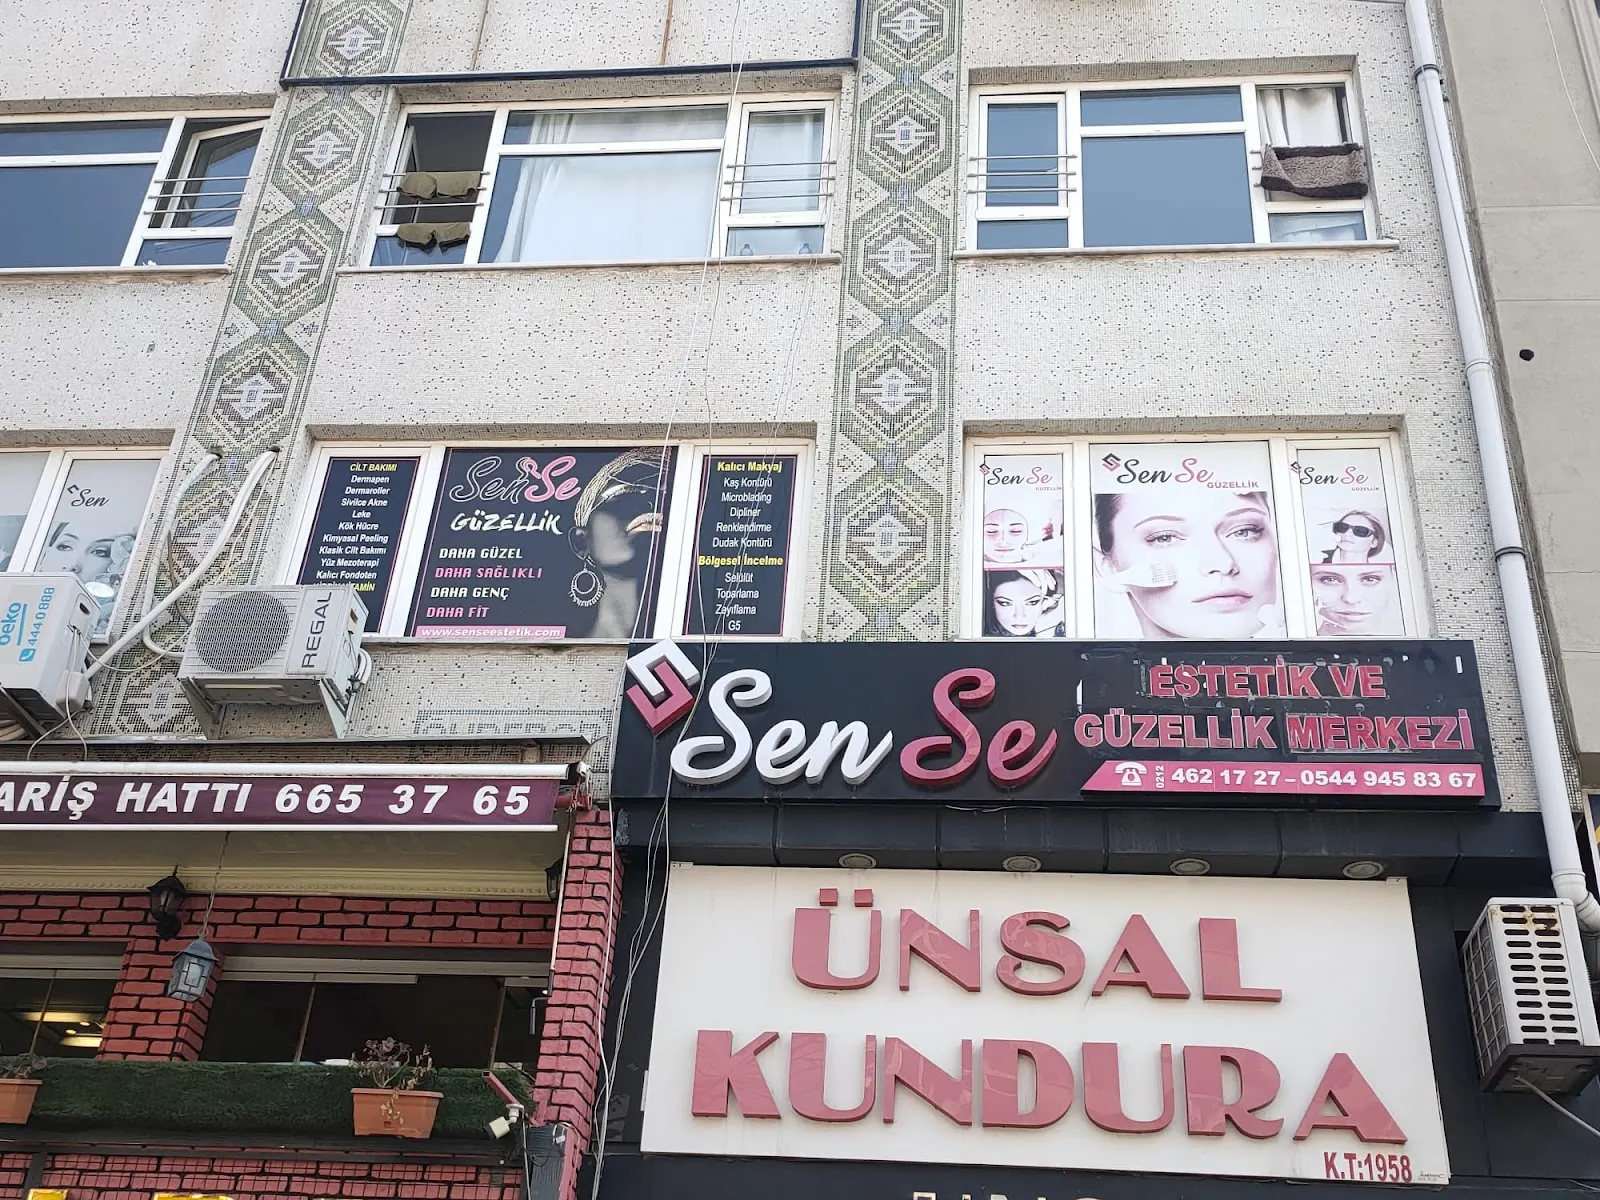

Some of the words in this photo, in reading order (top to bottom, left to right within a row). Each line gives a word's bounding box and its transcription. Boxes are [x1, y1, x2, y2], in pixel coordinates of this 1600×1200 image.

[350, 463, 369, 472] CİLT
[368, 463, 398, 472] BAKIMI
[747, 461, 782, 473] Makyaj
[1116, 458, 1172, 484] Sen
[1174, 457, 1214, 484] Se
[351, 475, 390, 485] Dermapen
[988, 467, 1025, 486] Sen
[1026, 466, 1053, 485] Se
[1300, 466, 1339, 485] Sen
[1340, 466, 1369, 485] Se
[723, 477, 740, 489] Kaş
[1207, 481, 1259, 489] GÜZELLİK
[71, 488, 109, 507] Sen
[341, 498, 367, 507] Sivilce
[367, 498, 388, 507] Akne
[721, 492, 772, 504] Microblading
[352, 510, 371, 518] Leke
[730, 507, 761, 519] Dipliner
[338, 522, 354, 530] Kök
[355, 522, 379, 531] Hücre
[450, 509, 563, 535] GÜZELLİK
[716, 522, 772, 532] Renklendirme
[322, 534, 359, 544] Kimyasal
[359, 534, 389, 544] Peeling
[712, 537, 739, 547] Dudak
[319, 546, 343, 554] Klasik
[344, 546, 359, 554] Cilt
[439, 548, 476, 559] DAHA
[480, 546, 523, 559] GÜZEL
[320, 558, 335, 567] Yüz
[336, 558, 380, 568] Mezoterapi
[698, 556, 741, 568] Bölgesel
[743, 553, 784, 565] İncelme
[434, 567, 472, 578] DAHA
[476, 565, 543, 578] SAĞLIKLI
[430, 587, 468, 598] DAHA
[472, 587, 510, 599] GENÇ
[716, 588, 759, 599] Toparlama
[426, 607, 464, 618] DAHA
[468, 606, 490, 618] FİT
[301, 591, 333, 668] REGAL
[728, 620, 741, 631] G5
[421, 627, 561, 638] www.senseestetik.com
[1148, 655, 1318, 698] ESTETİK
[1326, 665, 1387, 698] VE
[670, 668, 893, 786] Sen
[900, 667, 1058, 787] Se
[1073, 708, 1277, 749] GÜZELLİK
[1286, 708, 1475, 751] MERKEZİ
[1155, 765, 1164, 789] 0212
[1171, 768, 1213, 784] 462
[1220, 769, 1246, 785] 17
[1253, 770, 1281, 786] 27
[1300, 770, 1357, 786] 0544
[1363, 771, 1406, 787] 945
[1413, 772, 1441, 787] 83
[1448, 772, 1477, 788] 67
[115, 783, 253, 813] HATTI
[274, 784, 365, 813] 665
[388, 785, 449, 815] 37
[472, 786, 531, 816] 65
[791, 888, 1283, 1002] ÜNSAL
[691, 1029, 1407, 1145] KUNDURA
[1323, 1151, 1412, 1184] K.T:1958
